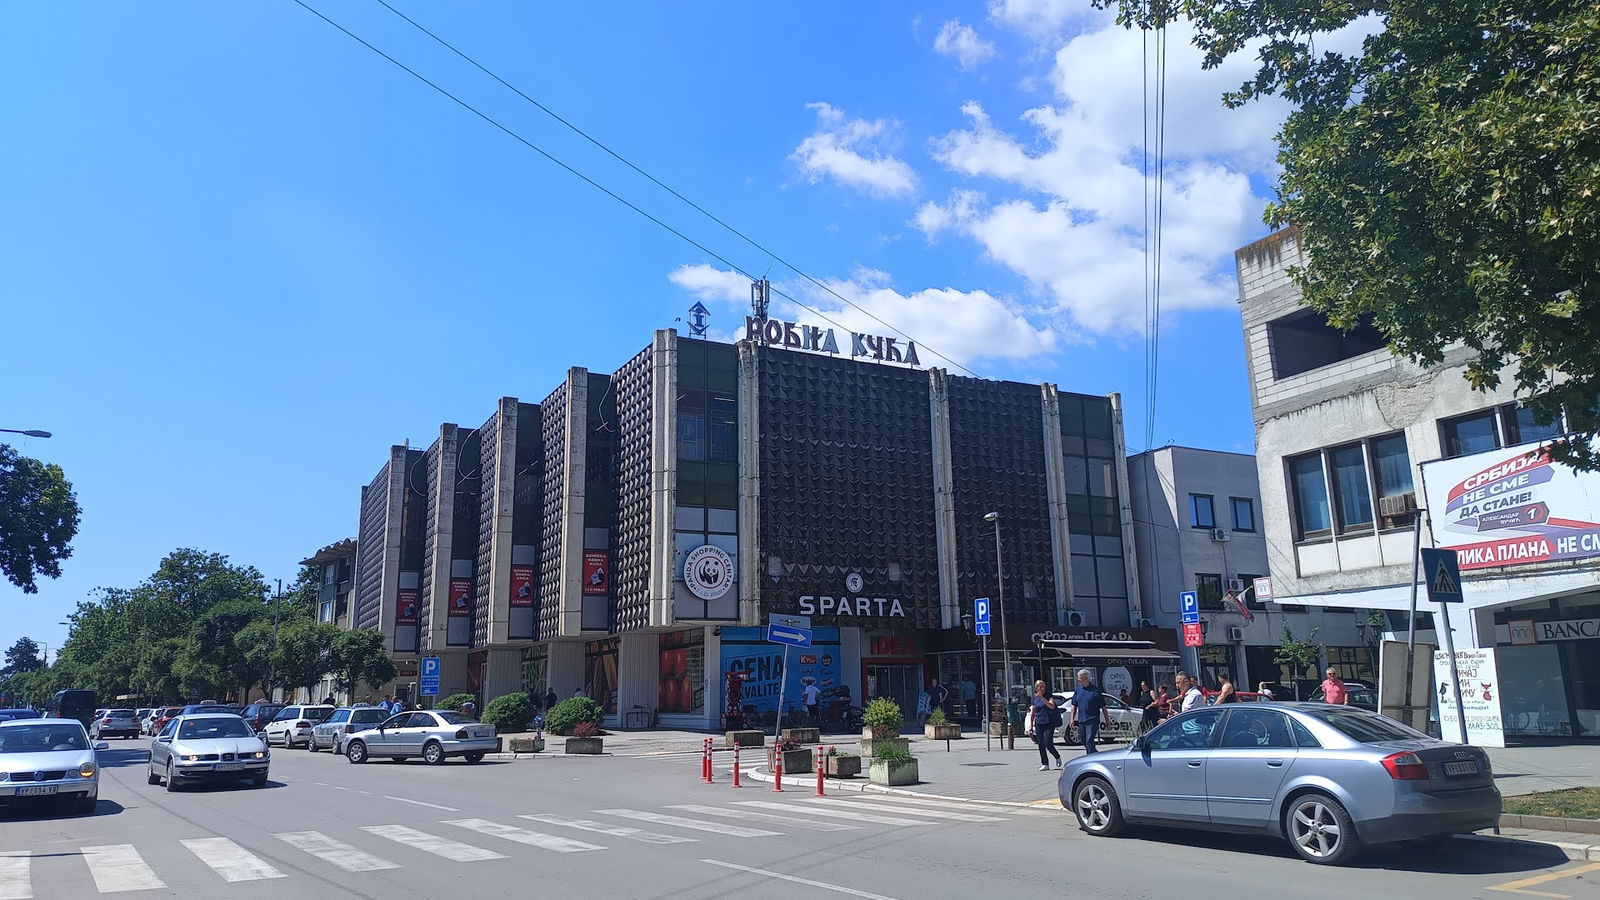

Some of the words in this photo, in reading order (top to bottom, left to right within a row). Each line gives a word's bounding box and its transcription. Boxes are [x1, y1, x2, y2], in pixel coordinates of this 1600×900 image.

[1463, 452, 1543, 490] СРБИЈА
[1462, 487, 1486, 505] НЕ
[1489, 473, 1530, 494] СМЕ
[1459, 505, 1480, 519] ДА
[1483, 491, 1532, 512] СТАНЕ!
[1527, 508, 1537, 520] 1
[1457, 547, 1496, 565] ЛИКА
[1497, 539, 1550, 561] ПЛАНА
[1557, 536, 1578, 554] НЕ
[686, 562, 695, 588] PANDA
[691, 547, 724, 561] SHOPPING
[723, 558, 732, 588] CENTAR
[799, 595, 905, 617] SPARTA
[978, 602, 987, 620] P
[1184, 594, 1194, 611] P
[425, 660, 436, 674] P
[731, 654, 784, 682] CENA
[1456, 669, 1478, 678] ИЧАЈ
[740, 682, 782, 699] VALITE
[1457, 688, 1476, 698] ИЧУ
